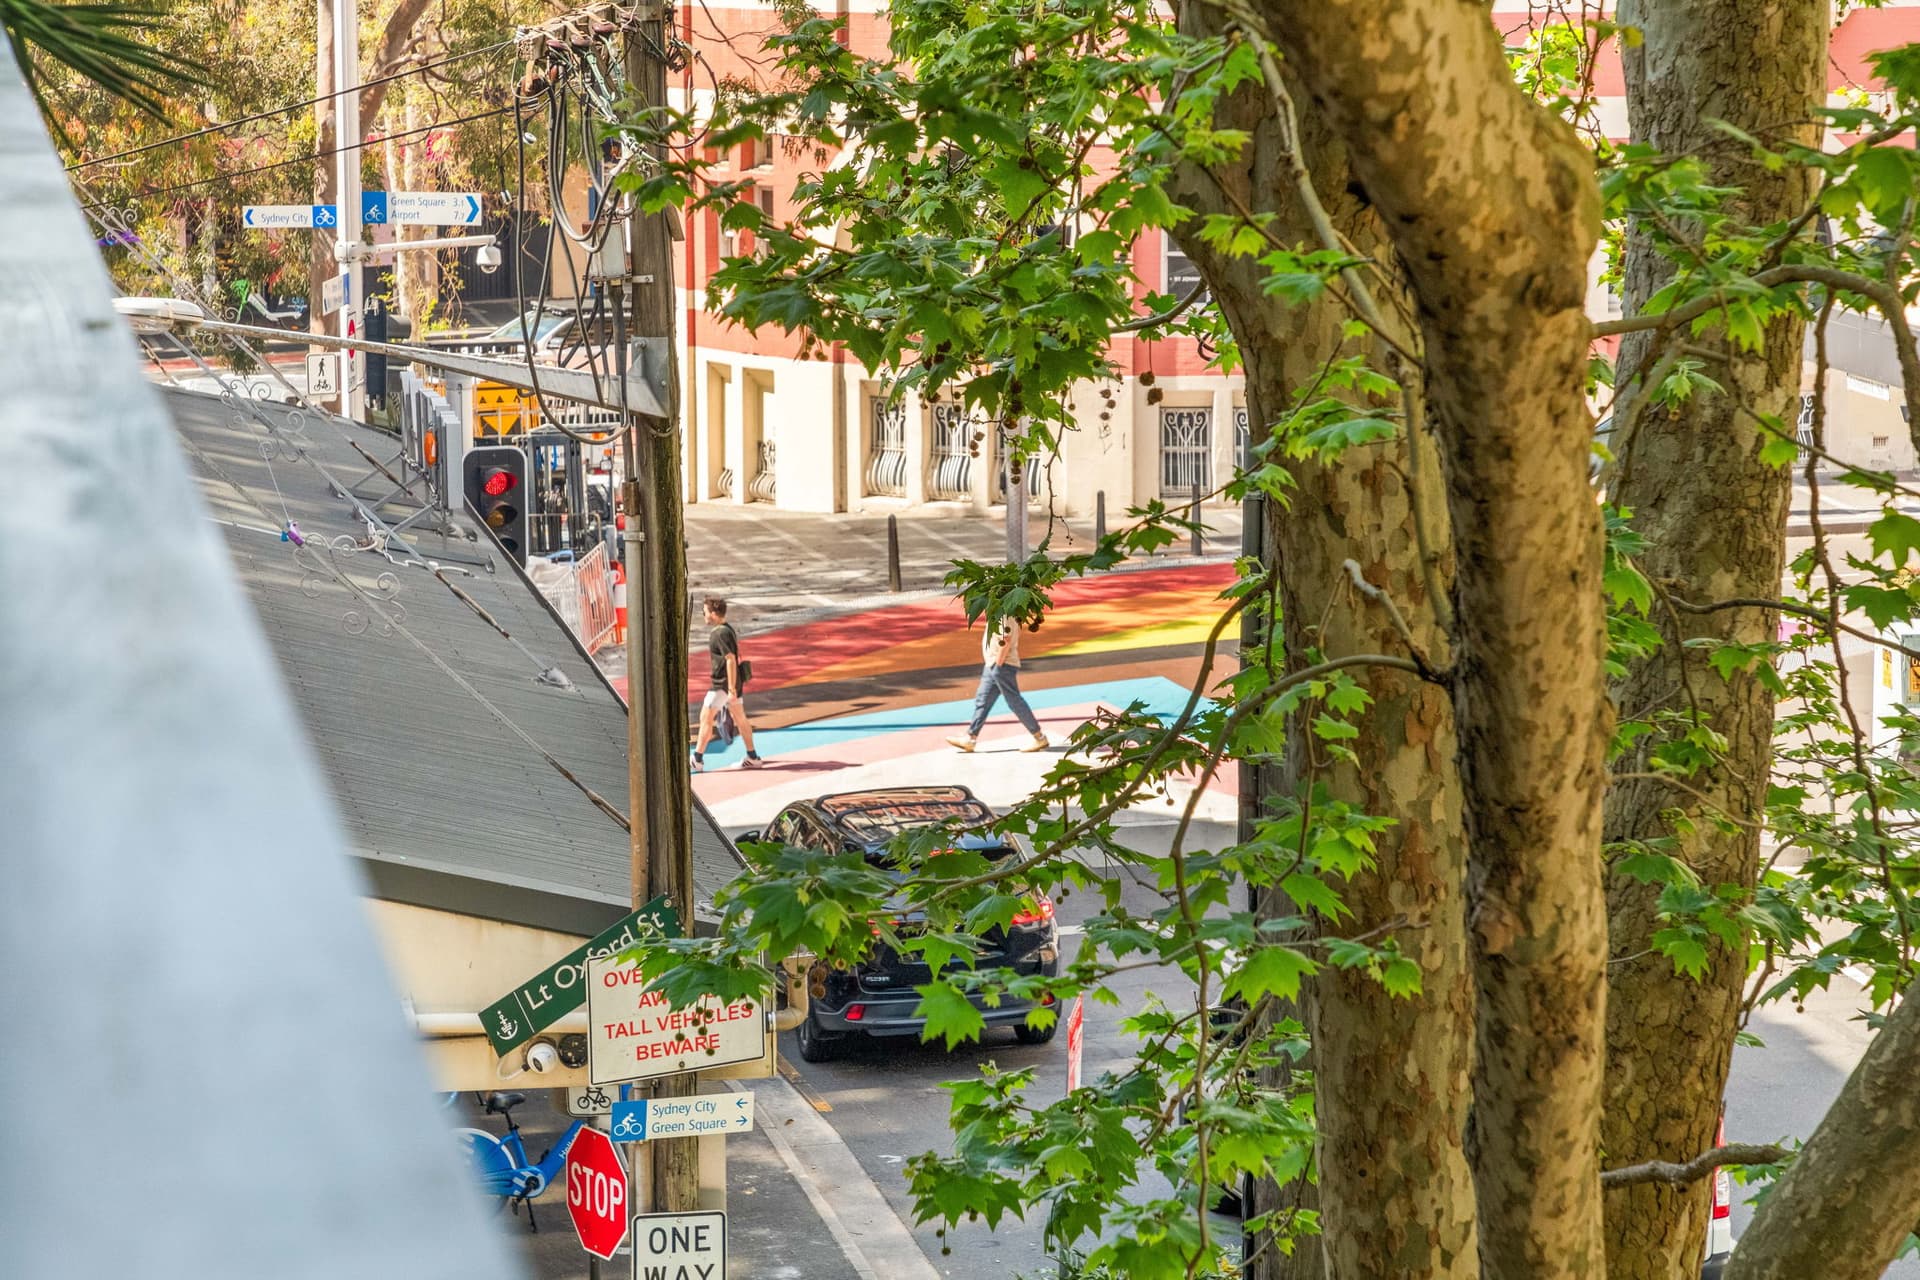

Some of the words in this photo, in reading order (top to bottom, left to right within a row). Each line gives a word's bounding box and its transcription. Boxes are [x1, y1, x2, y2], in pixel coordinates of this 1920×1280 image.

[391, 196, 415, 206] Green
[418, 197, 446, 208] Square
[261, 213, 290, 225] Sydney
[292, 213, 309, 225] City
[391, 209, 420, 220] Airport
[524, 983, 553, 1010] Lt
[637, 911, 665, 938] St
[604, 1020, 652, 1040] TALL
[636, 1033, 721, 1061] BEWARE
[652, 1102, 693, 1118] Sydney
[694, 1100, 717, 1114] City
[651, 1121, 685, 1134] Green
[688, 1118, 727, 1133] Square
[570, 1161, 624, 1222] STOP
[649, 1225, 711, 1254] ONE
[644, 1263, 715, 1280] WAY
